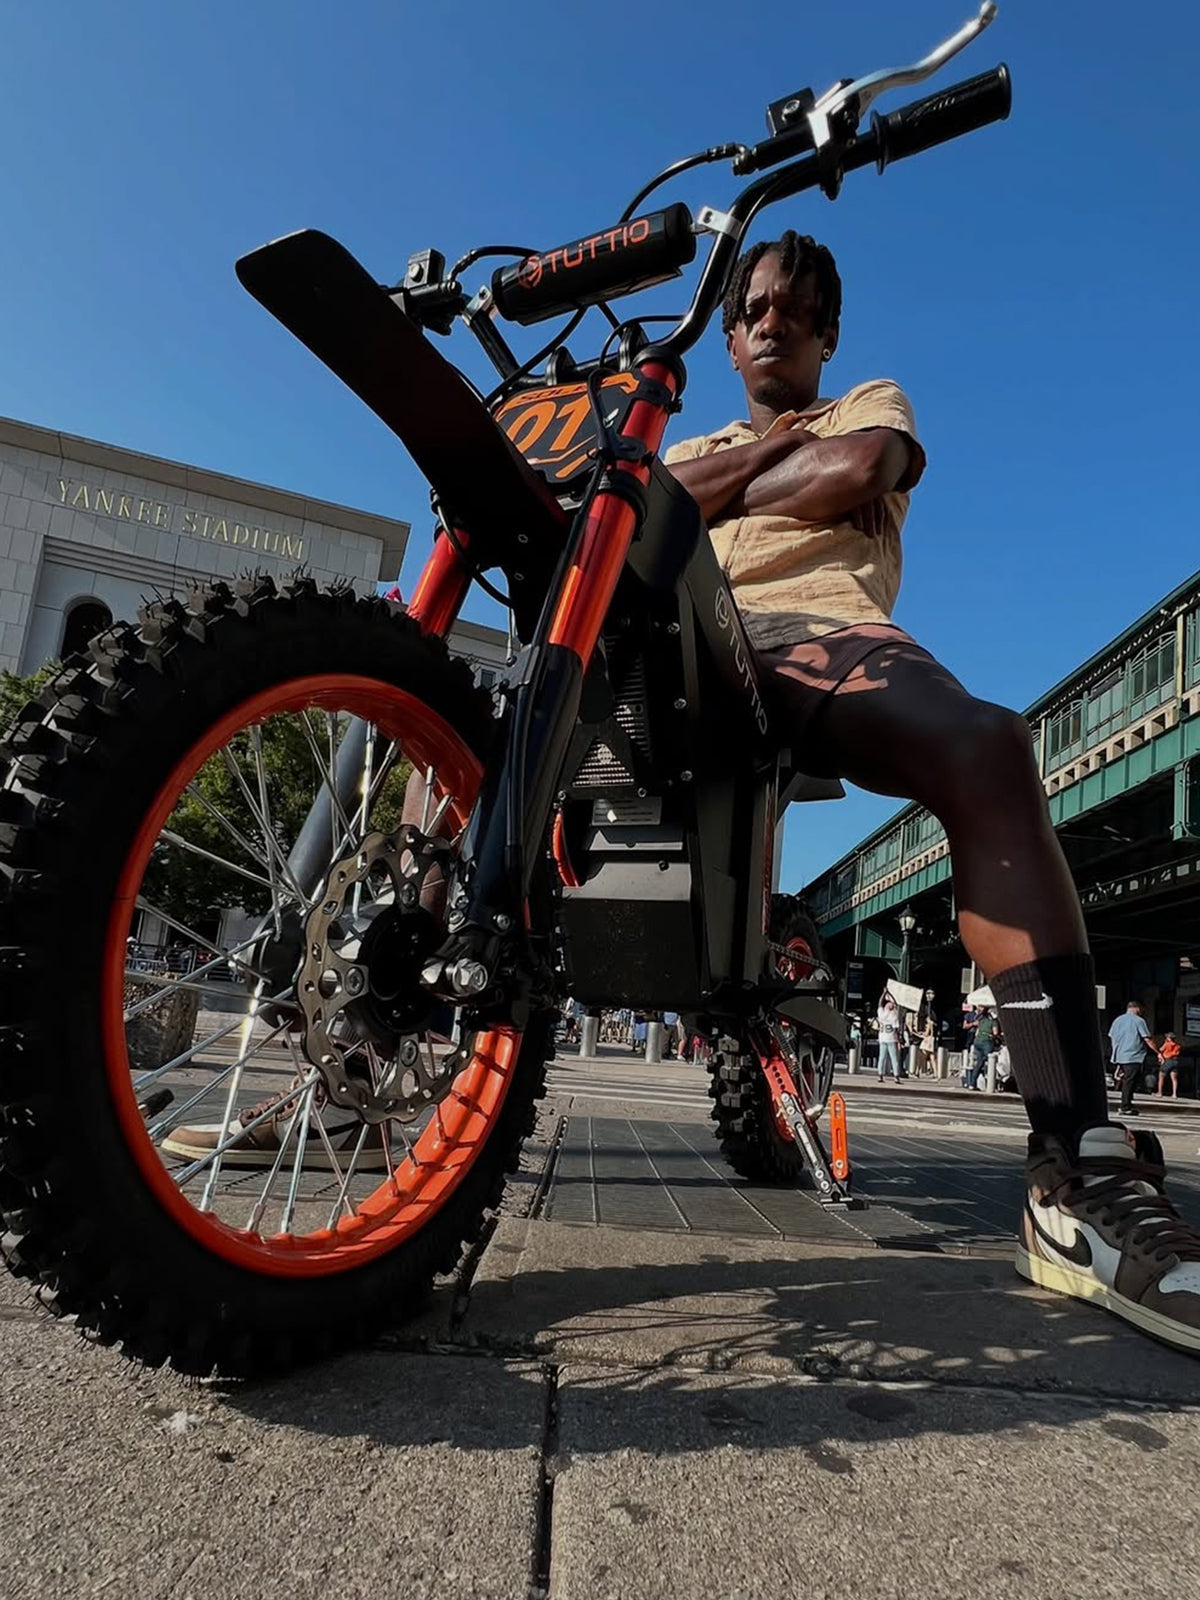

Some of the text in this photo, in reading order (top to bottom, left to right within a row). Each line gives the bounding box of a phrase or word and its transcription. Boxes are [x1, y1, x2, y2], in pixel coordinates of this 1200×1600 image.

[548, 218, 650, 273] TUTTIO
[506, 393, 591, 454] 01
[57, 479, 303, 560] YANKEE STADIUM
